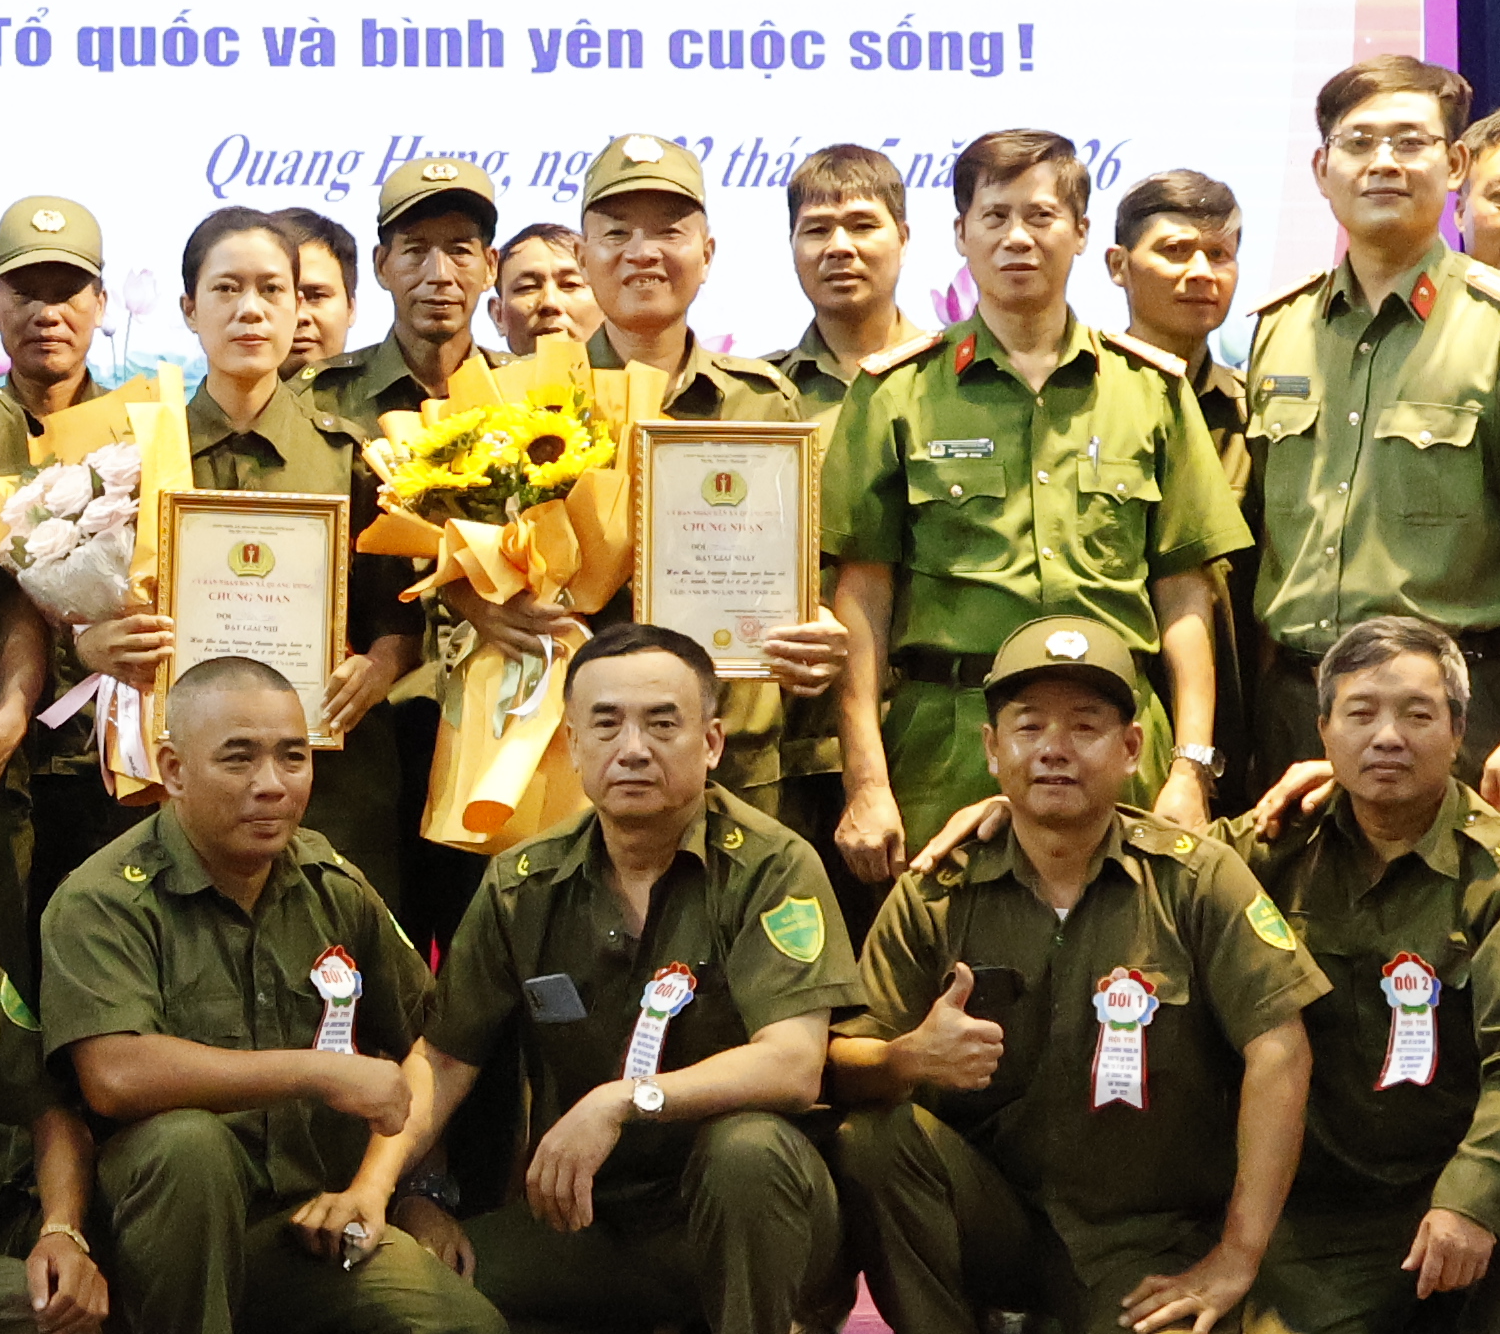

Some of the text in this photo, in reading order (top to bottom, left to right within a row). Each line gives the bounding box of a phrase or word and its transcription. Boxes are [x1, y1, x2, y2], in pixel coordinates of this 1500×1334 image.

[76, 9, 241, 72] quốc
[262, 15, 336, 67] và
[361, 17, 505, 68] bình
[528, 18, 644, 73] yên
[668, 19, 827, 79] cuộc
[849, 13, 1035, 78] sống!
[204, 134, 364, 202] Quang
[721, 136, 814, 187] thá
[903, 138, 967, 188] nă
[1070, 138, 1132, 191] 26
[1394, 972, 1430, 993] ĐỘI 2
[675, 988, 684, 1001] 1
[1108, 990, 1144, 1009] ĐỘI 1
